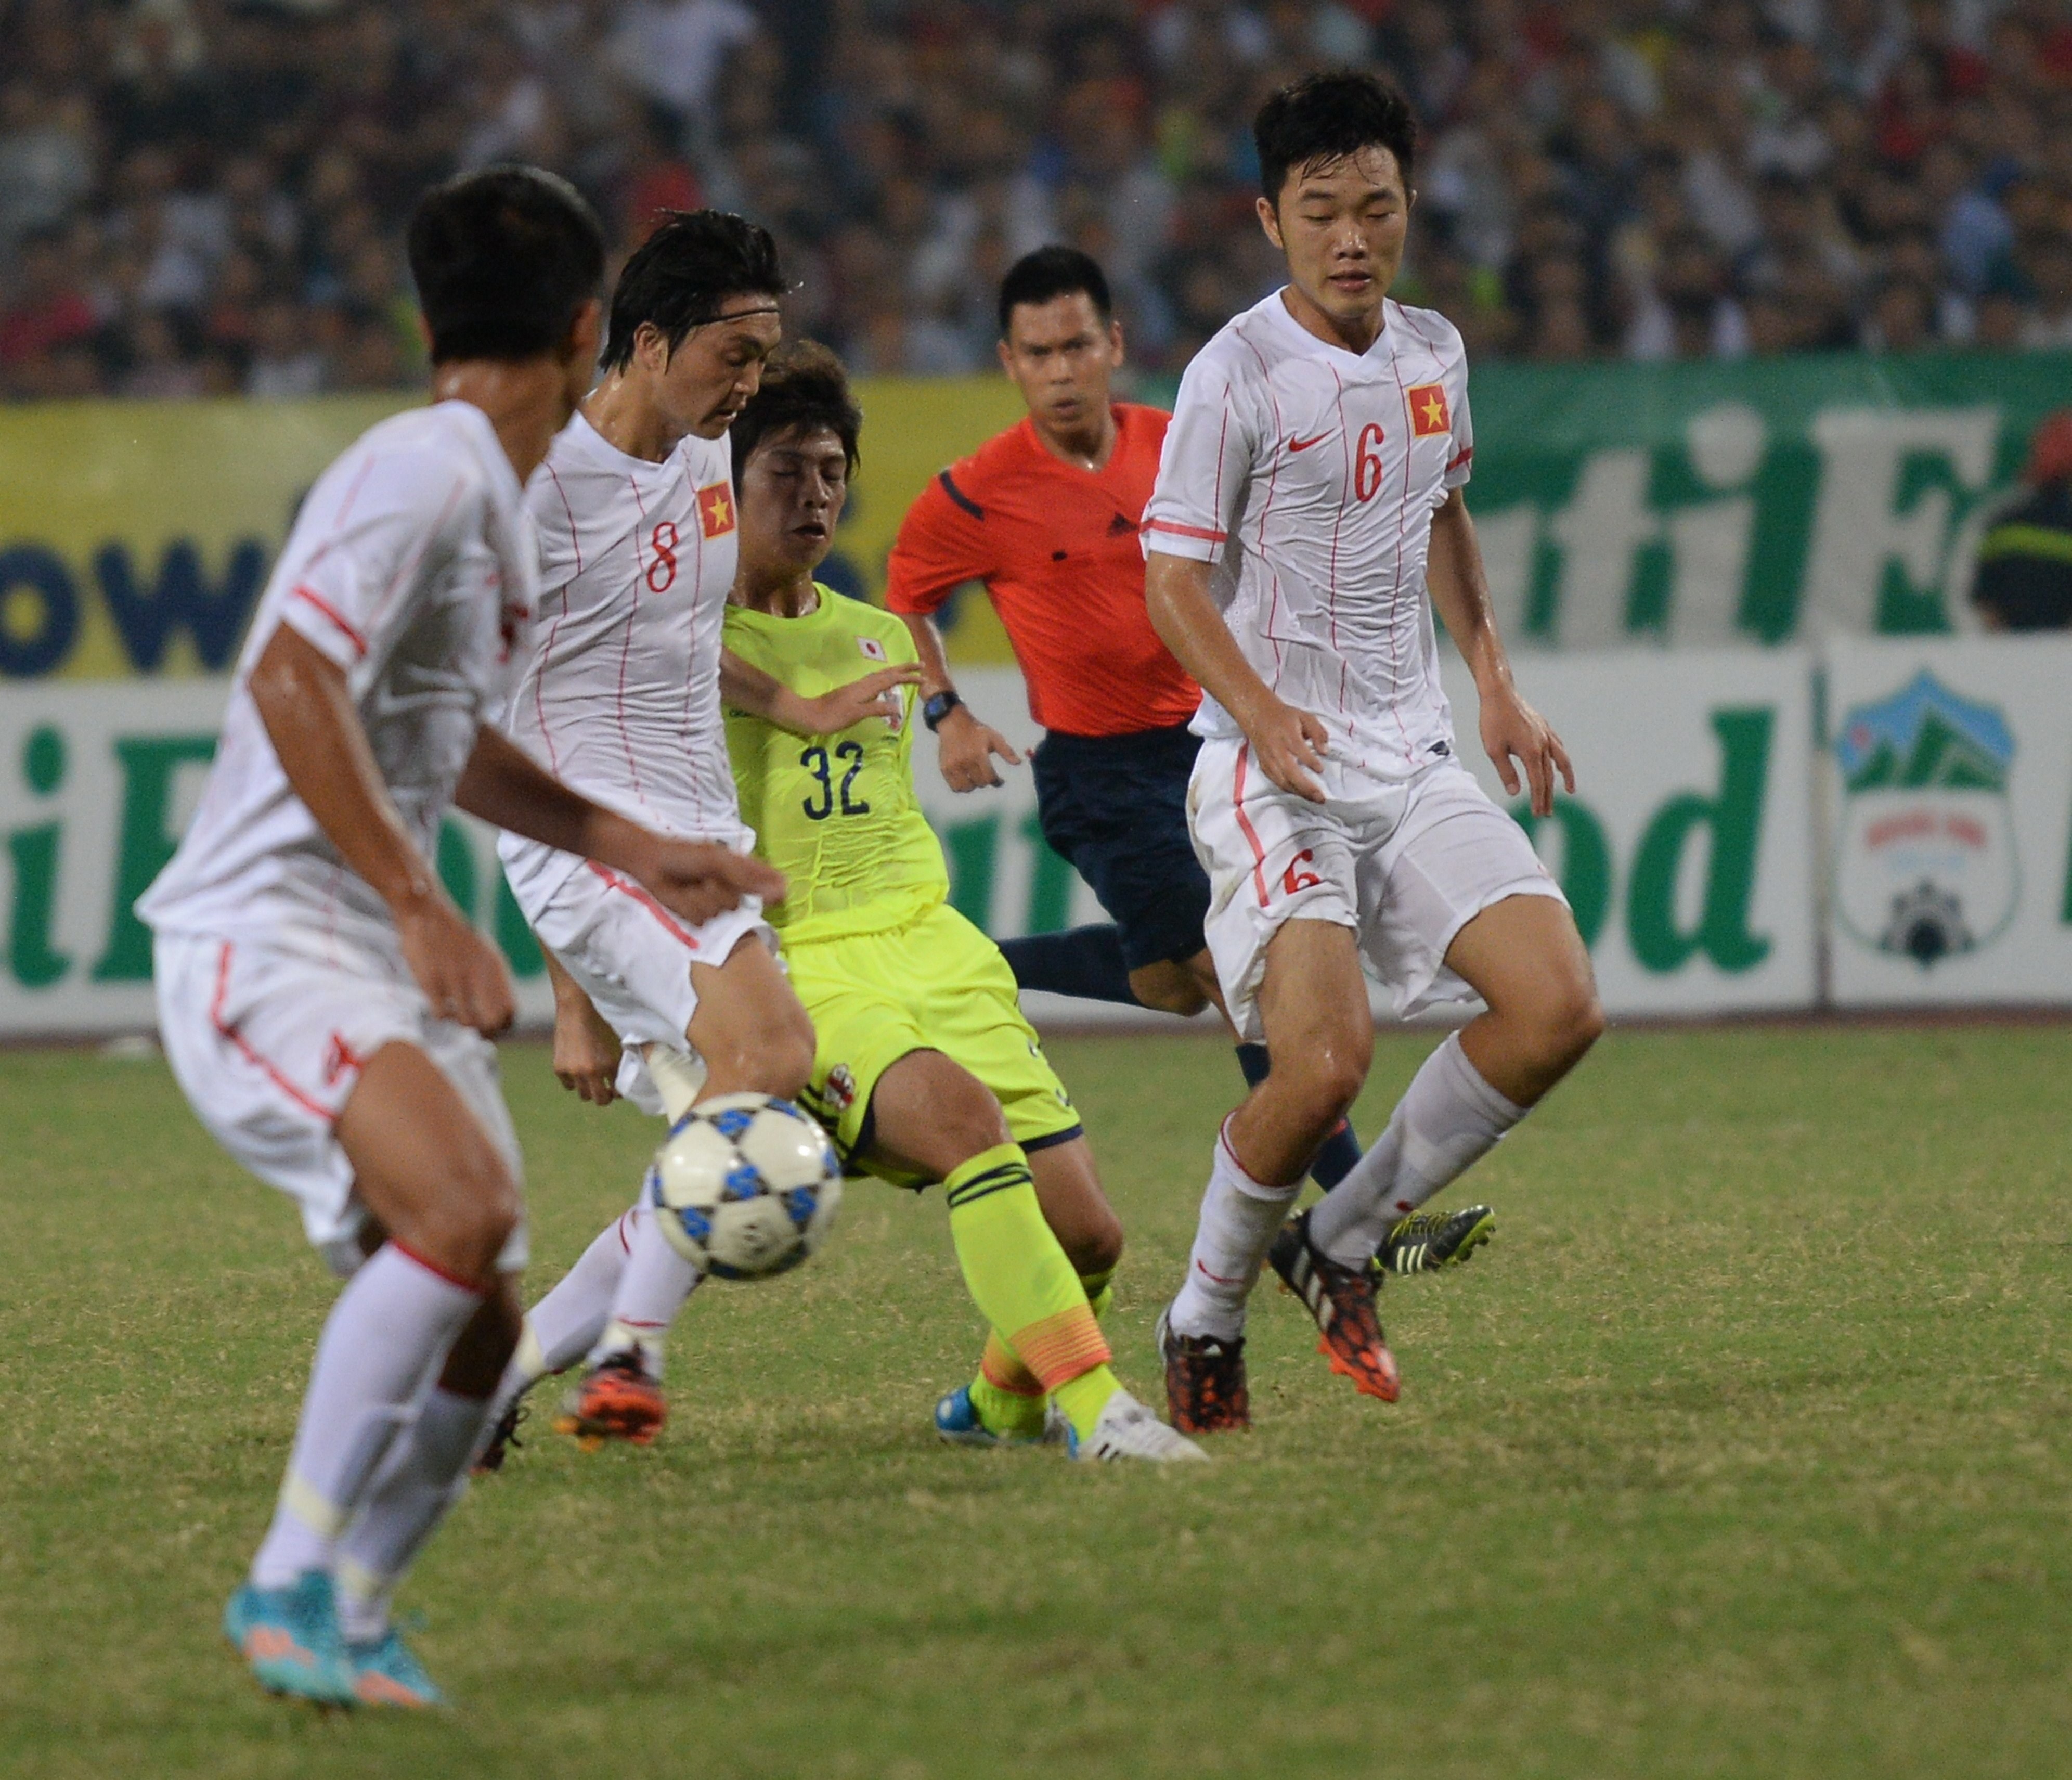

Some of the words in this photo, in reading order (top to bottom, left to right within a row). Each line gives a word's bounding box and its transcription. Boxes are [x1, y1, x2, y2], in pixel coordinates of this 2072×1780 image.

[1354, 422, 1385, 503] 6
[646, 521, 678, 594] 8
[800, 740, 870, 821] 32
[1283, 848, 1320, 895] 6
